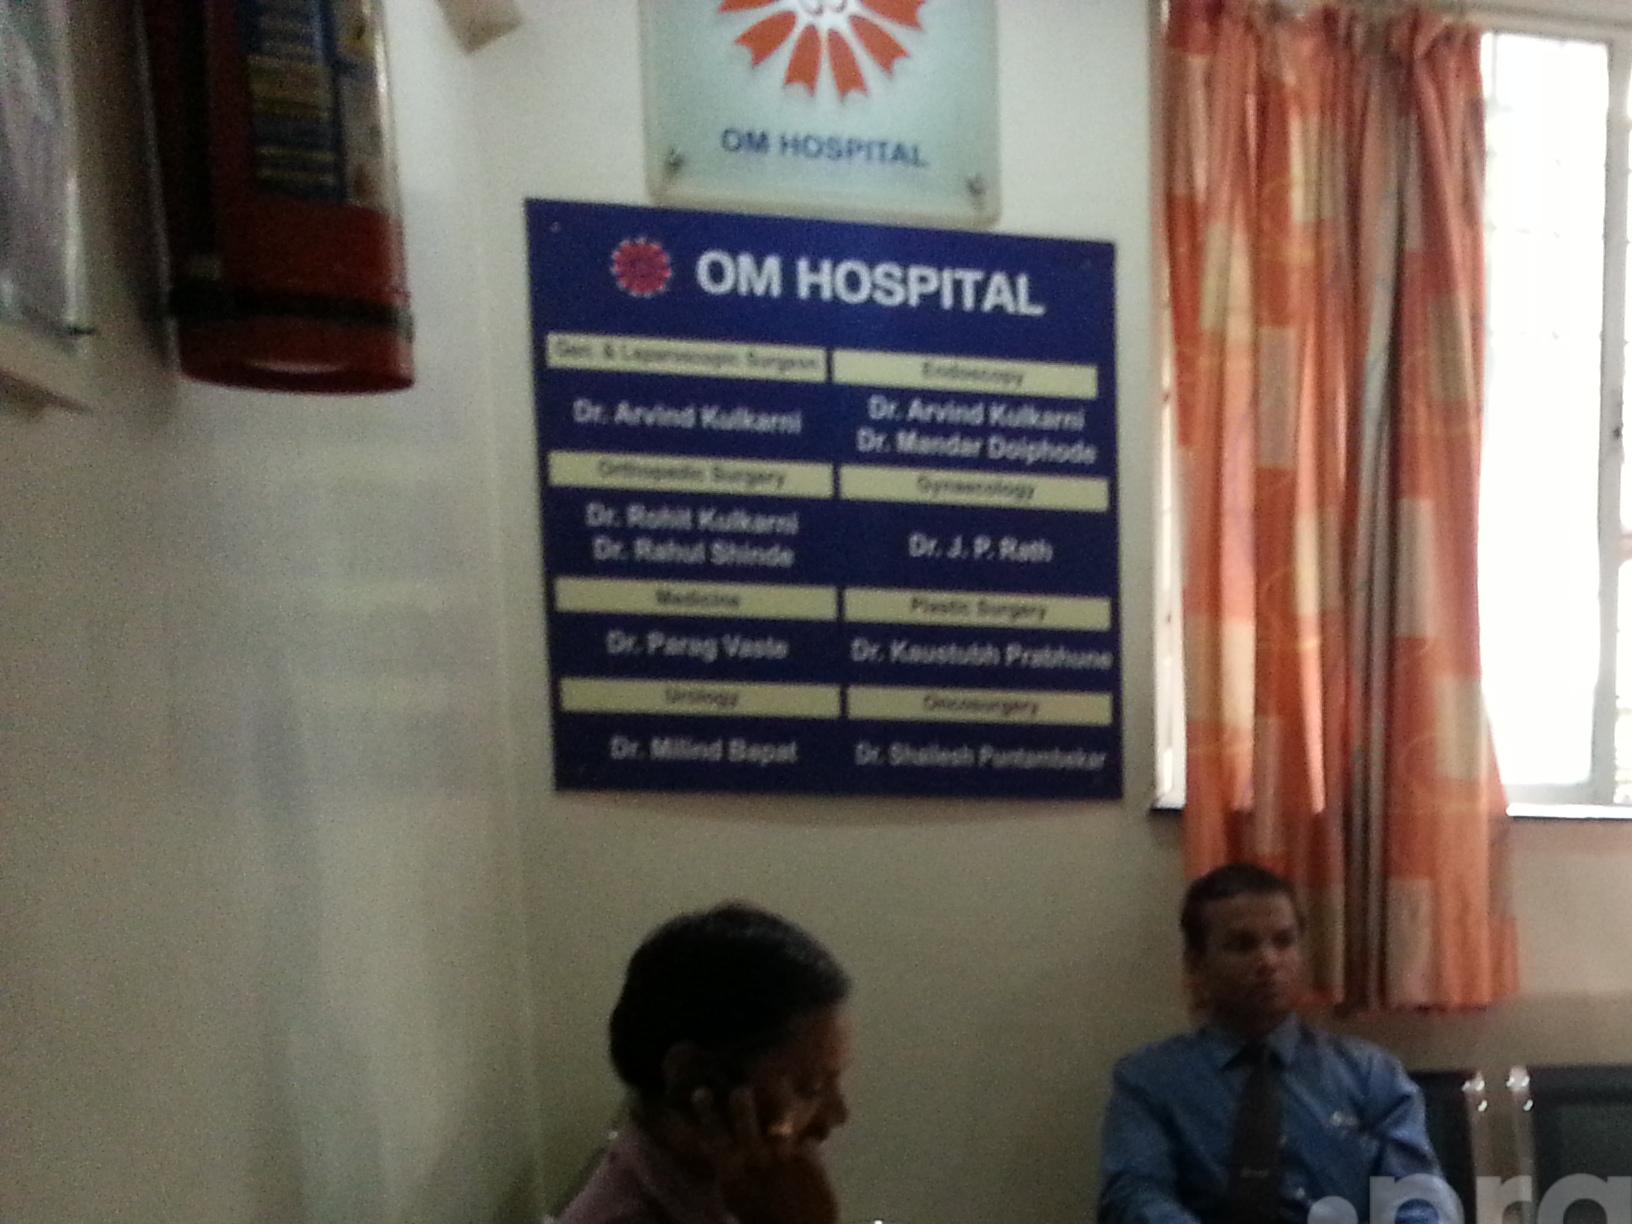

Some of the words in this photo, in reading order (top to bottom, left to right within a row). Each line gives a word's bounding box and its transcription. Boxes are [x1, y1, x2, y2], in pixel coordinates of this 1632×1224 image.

[720, 127, 770, 155] OM
[779, 130, 928, 169] HOSPITAL
[696, 249, 782, 298] OM
[797, 257, 1046, 317] HOSPITAL
[922, 361, 1024, 388] Endoscopy
[573, 398, 609, 425] Dr.
[614, 400, 696, 429] Arvind
[701, 404, 803, 434] Kulkarni
[867, 394, 901, 421] Dr.
[907, 397, 985, 426] Arvind
[989, 401, 1086, 432] Kulkarni
[856, 427, 890, 454] Dr.
[896, 430, 982, 458] Mandar
[712, 463, 786, 489] Surgery
[585, 500, 621, 528] Dr.
[698, 506, 800, 536] Kulkarni
[592, 534, 628, 561] Dr.
[633, 536, 706, 563] Rahul
[710, 539, 795, 568] Shinde
[908, 531, 942, 558] Dr.
[946, 534, 968, 560] J.
[973, 535, 994, 561] P.
[655, 589, 740, 609] Medicine
[910, 597, 969, 616] Plastic
[977, 599, 1048, 624] Surgery
[605, 628, 641, 656] Dr.
[646, 630, 719, 663] Parag
[850, 636, 886, 663] Dr.
[890, 638, 1001, 667] Kaustubh
[609, 735, 645, 760] Dr.
[650, 736, 723, 762] Milind
[855, 739, 886, 766] Dr.
